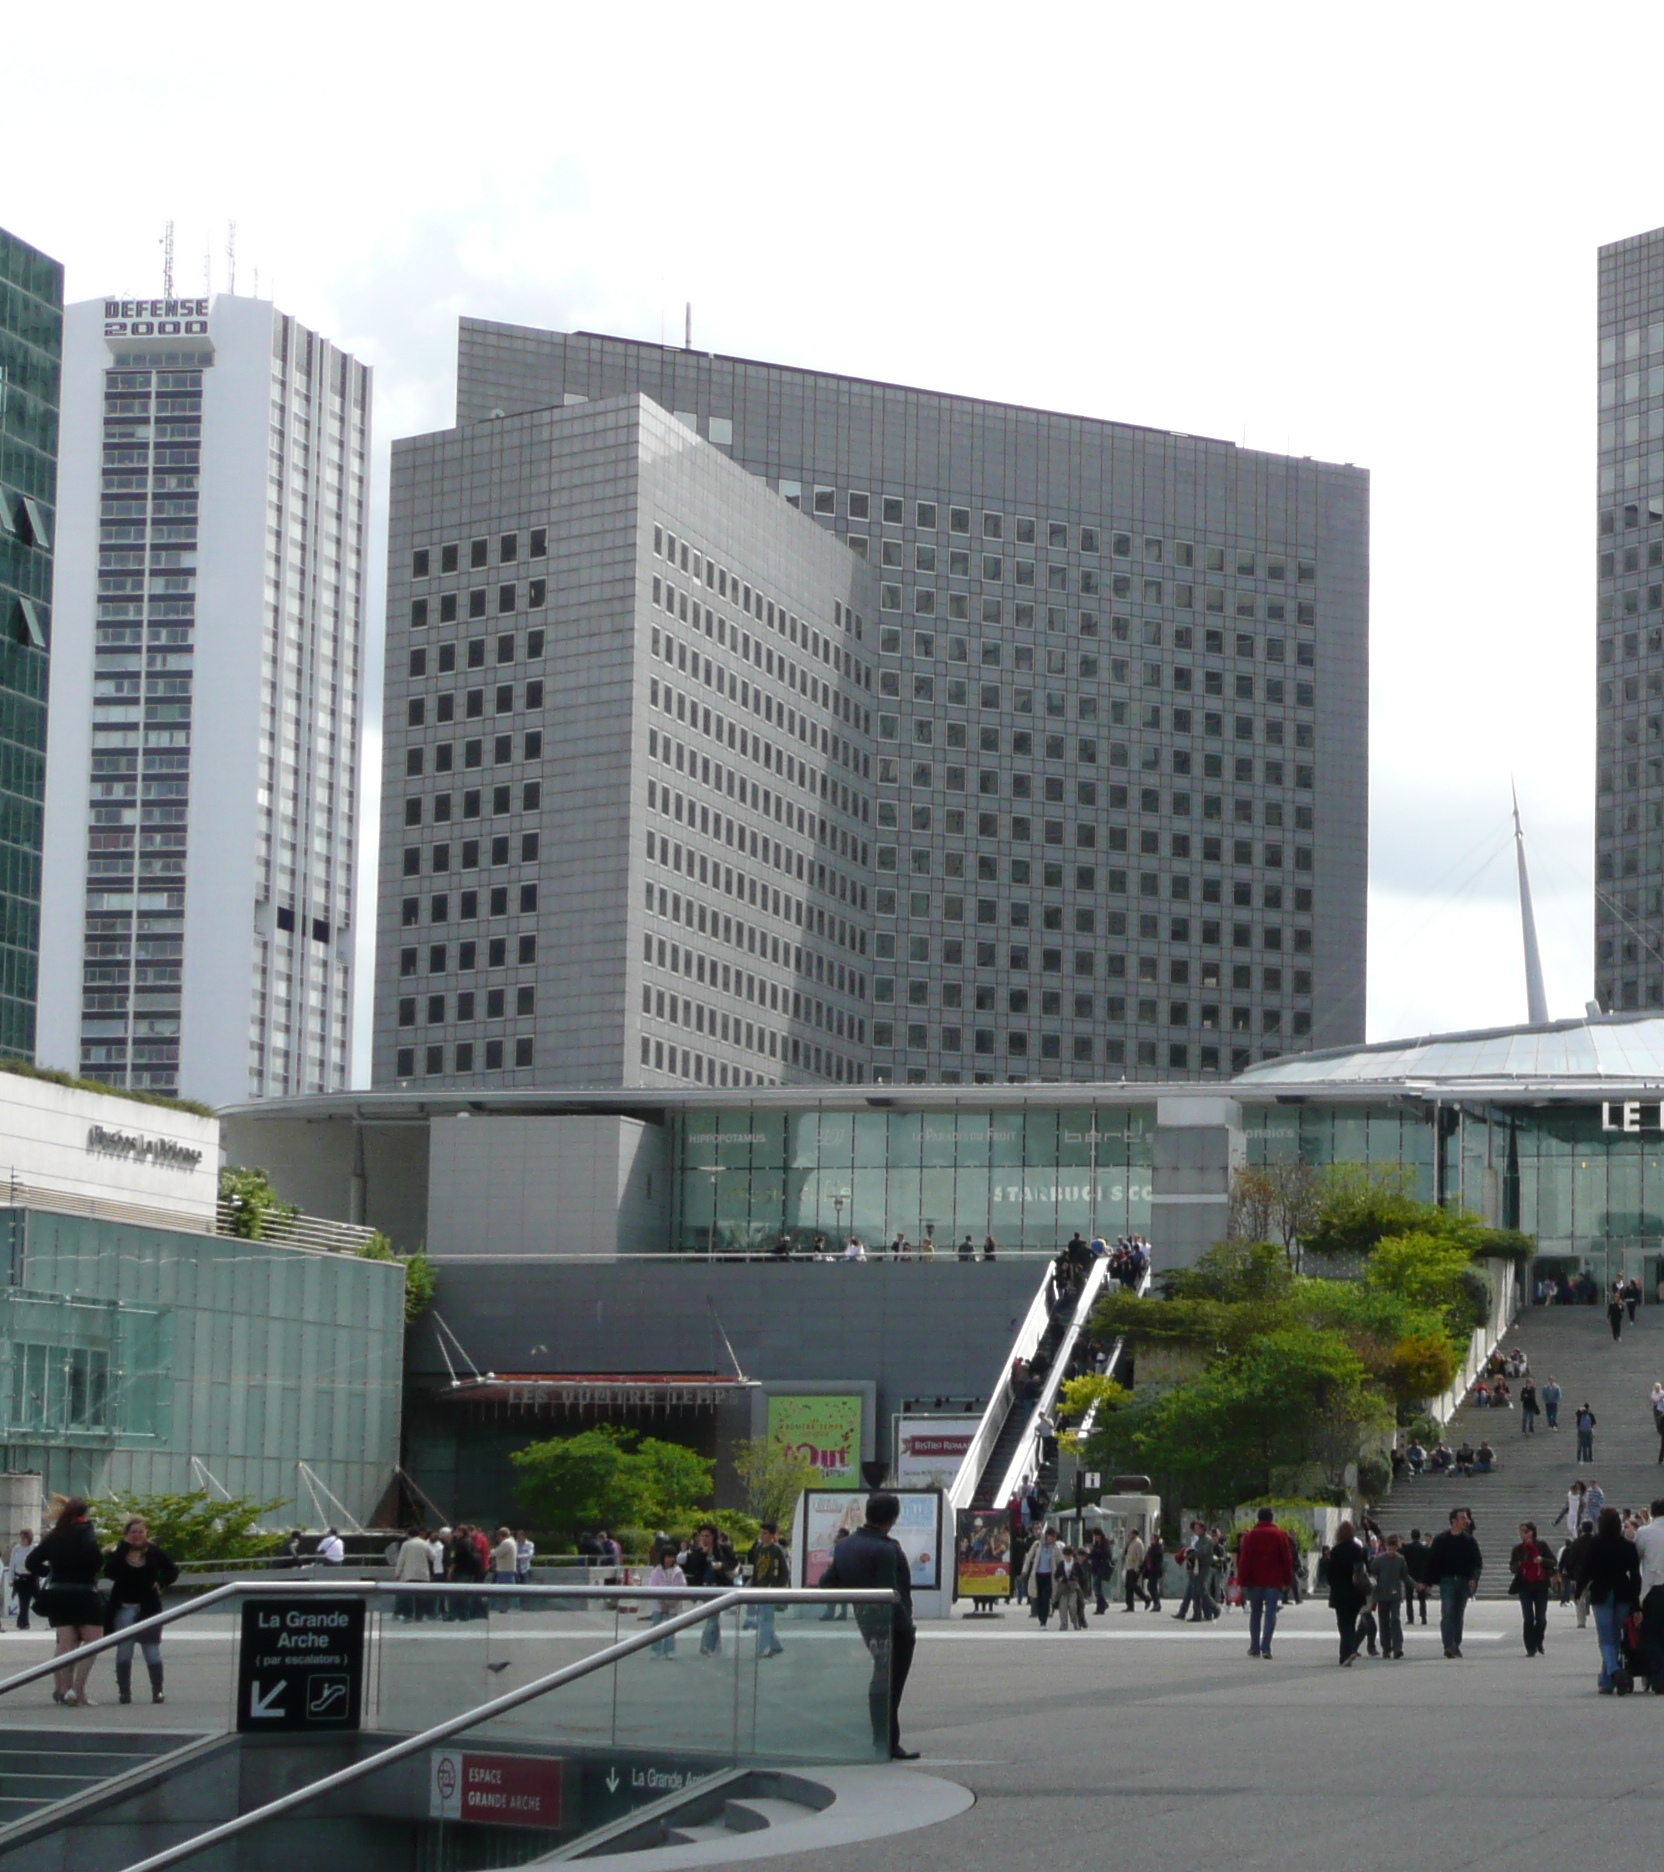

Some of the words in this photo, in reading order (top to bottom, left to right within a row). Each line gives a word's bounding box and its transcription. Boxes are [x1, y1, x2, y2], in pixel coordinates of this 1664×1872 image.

[104, 299, 208, 318] DEFENSE
[104, 321, 208, 336] 2000
[1602, 1101, 1640, 1132] LE
[689, 1133, 766, 1143] HIPPOPOTAMUS
[508, 1388, 548, 1404] LES
[914, 1441, 942, 1450] BISTRO
[258, 1611, 280, 1628] La
[286, 1610, 349, 1628] Grande
[277, 1631, 329, 1648] Arche
[468, 1767, 502, 1784] ESPACE
[631, 1767, 645, 1786] La
[648, 1767, 682, 1788] Grande
[467, 1790, 507, 1808] GRANDE
[509, 1794, 541, 1811] ARCHE
